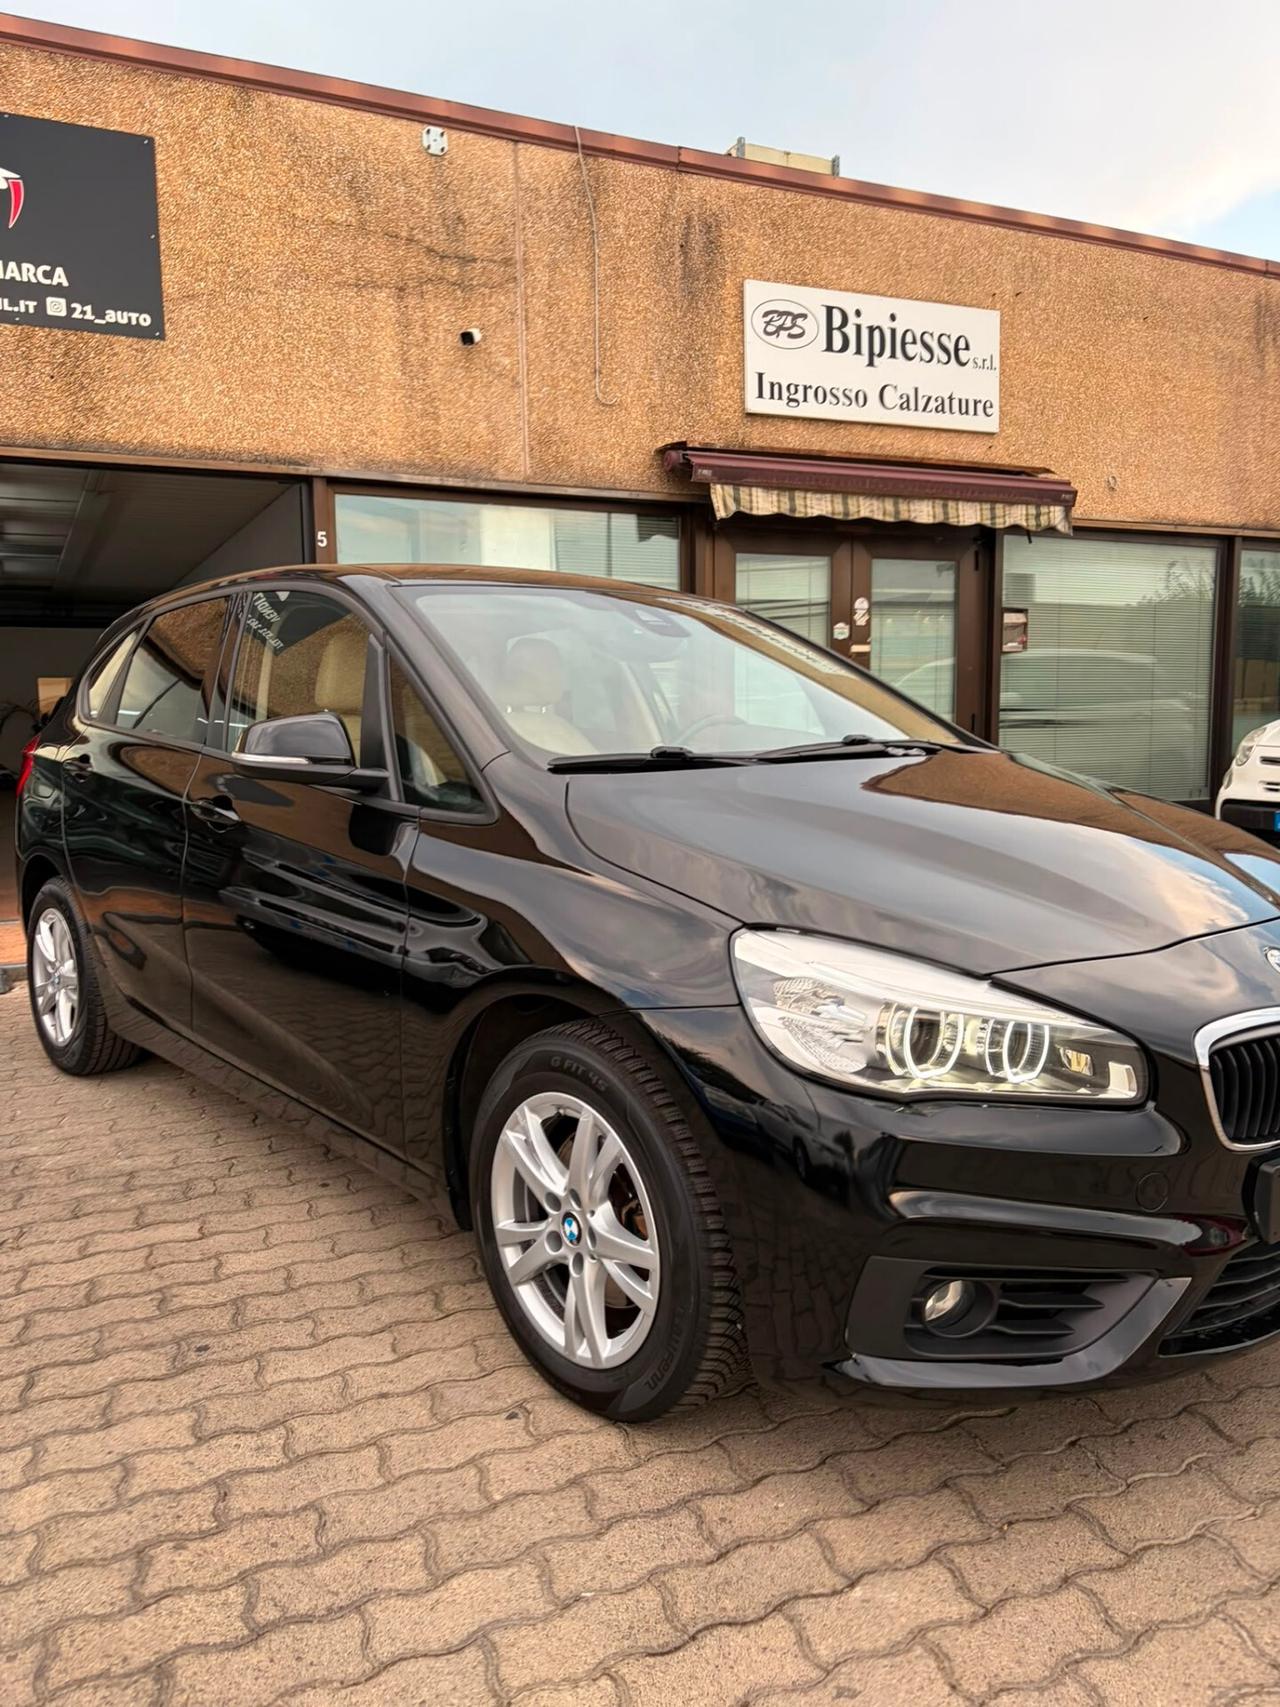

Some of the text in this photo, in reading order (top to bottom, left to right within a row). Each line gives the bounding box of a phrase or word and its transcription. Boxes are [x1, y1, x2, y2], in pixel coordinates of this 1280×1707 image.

[820, 304, 997, 371] Bipiesse s.r.l.
[754, 371, 994, 417] Ingrosso Calzature
[317, 530, 328, 548] 5
[563, 1059, 587, 1075] FIT
